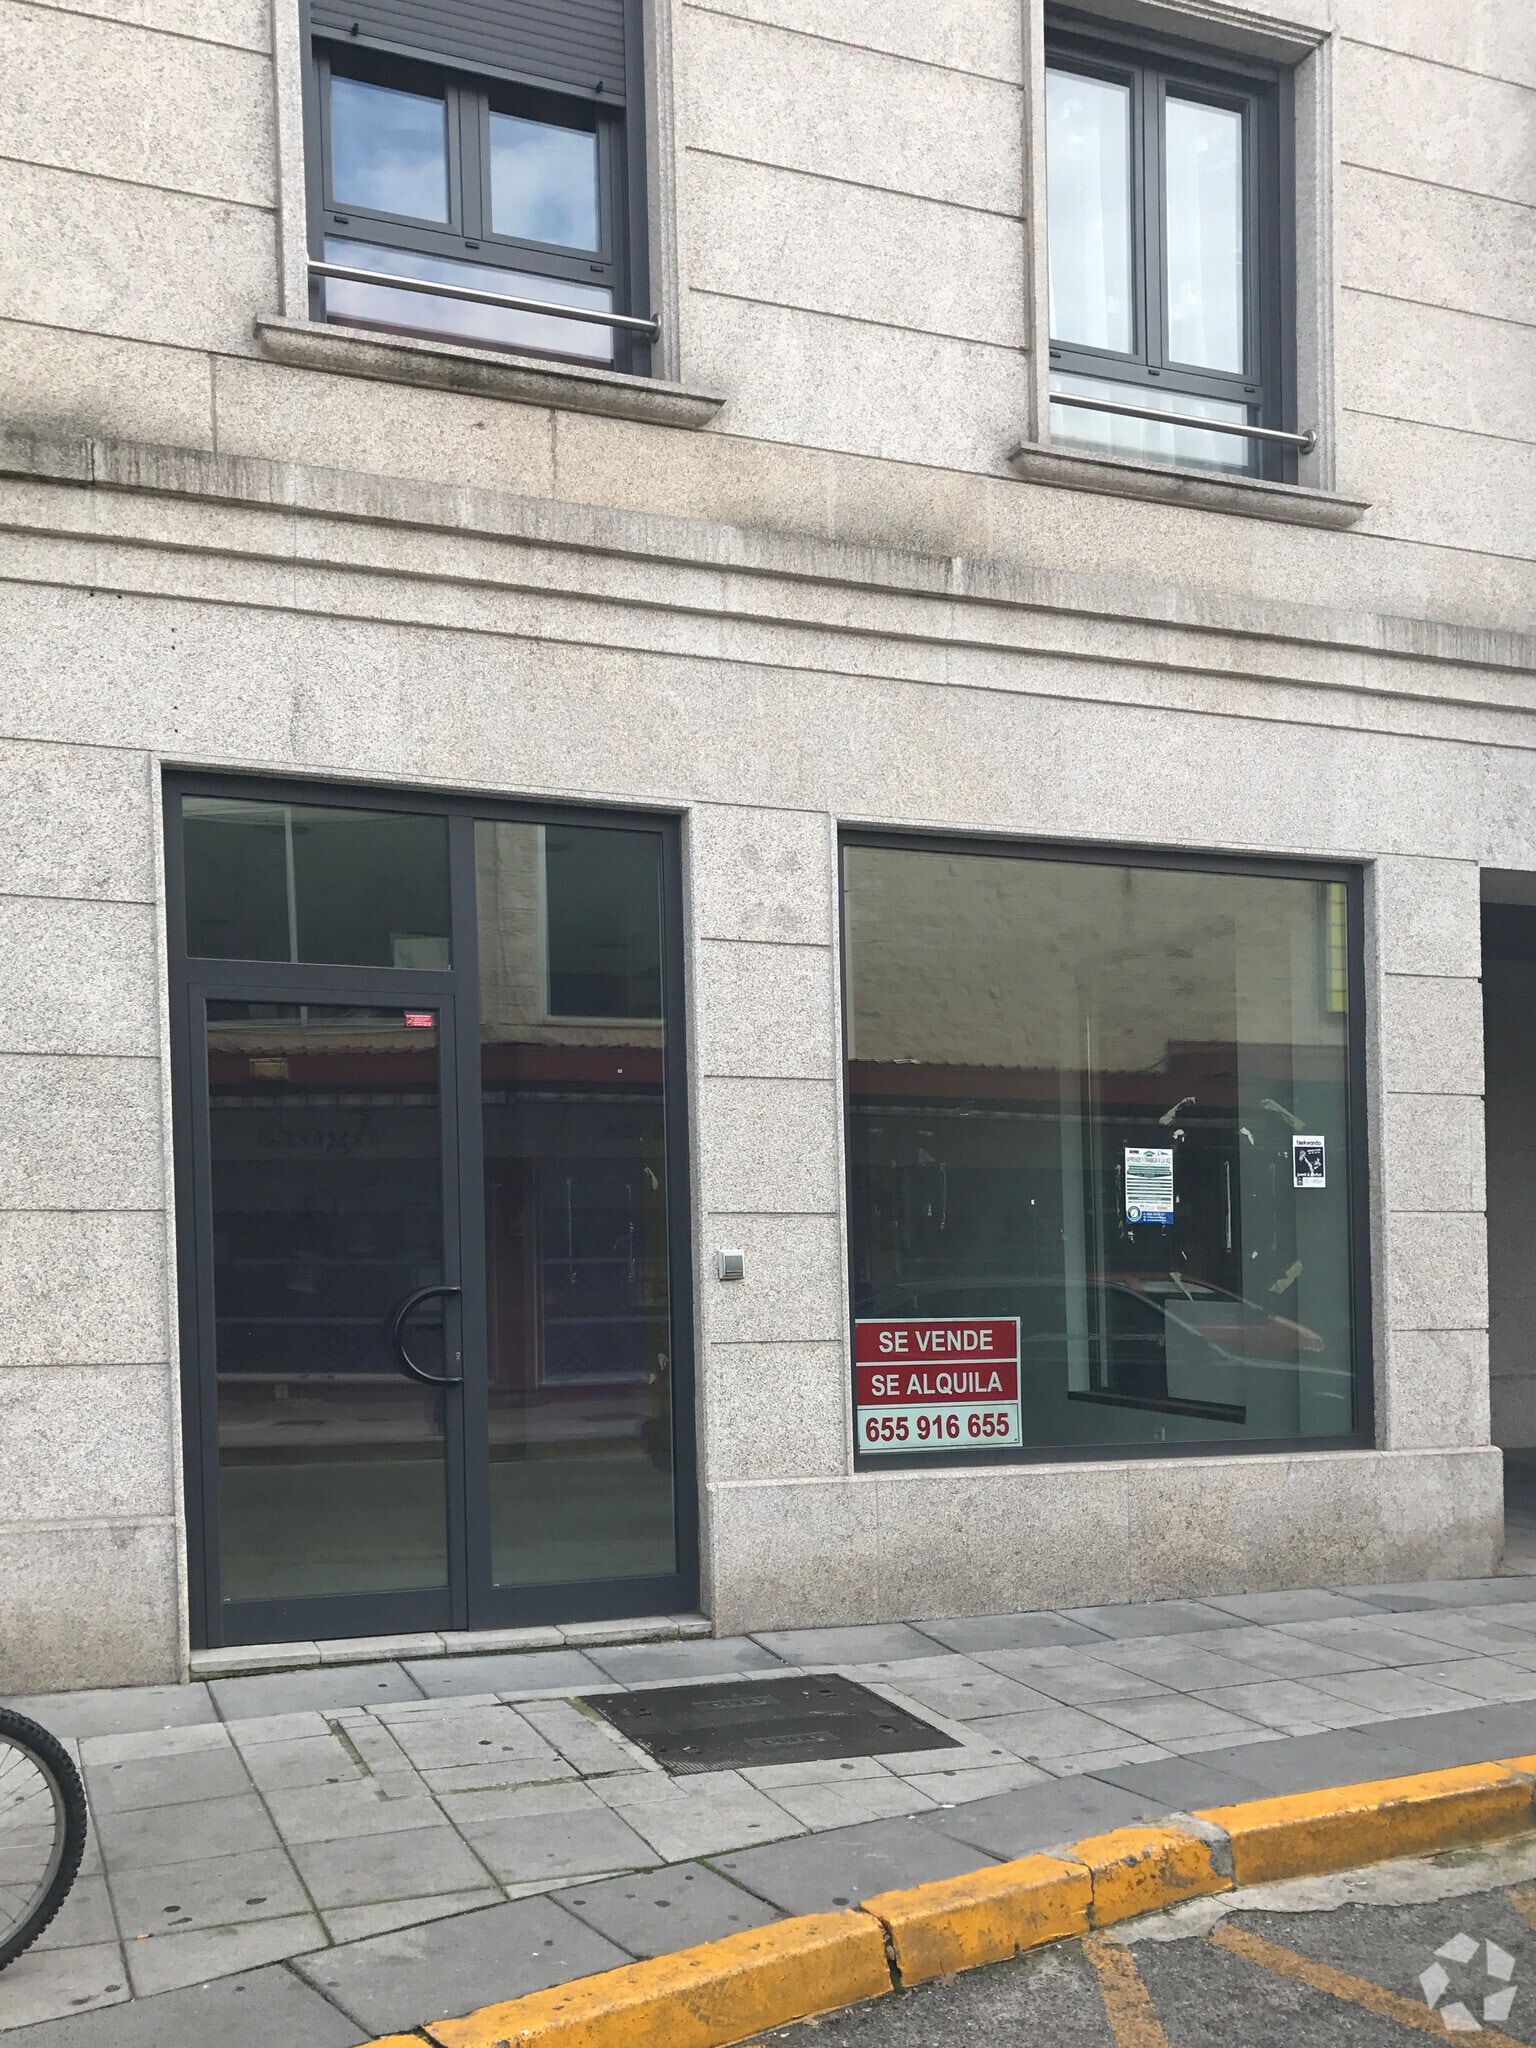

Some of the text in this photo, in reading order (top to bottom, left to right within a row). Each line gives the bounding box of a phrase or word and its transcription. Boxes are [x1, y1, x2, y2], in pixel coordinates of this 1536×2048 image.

[879, 1329, 993, 1353] SE VENDE
[871, 1371, 1003, 1396] SE ALQUILA
[865, 1412, 1010, 1442] 655 916 655
